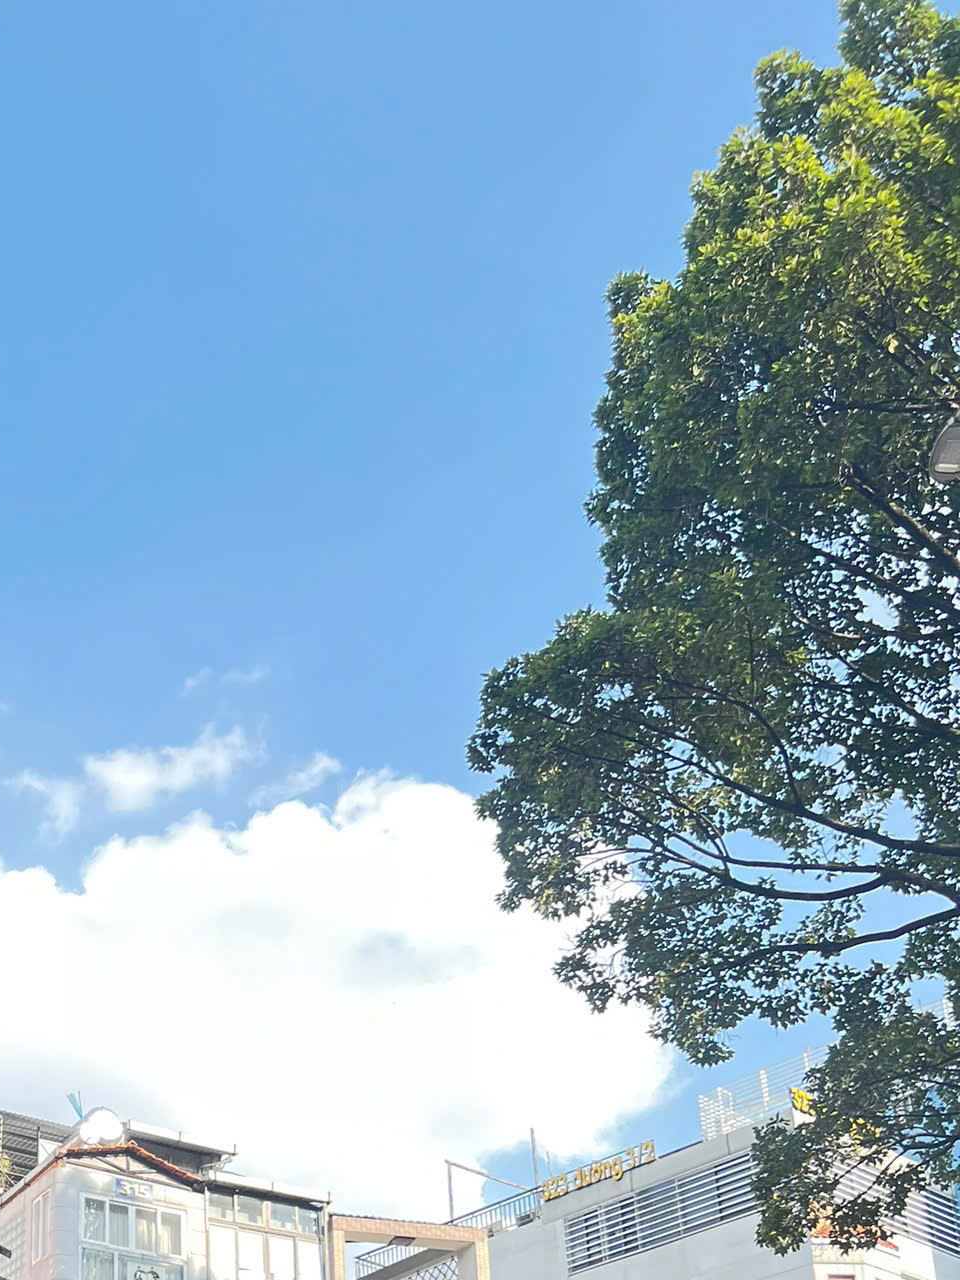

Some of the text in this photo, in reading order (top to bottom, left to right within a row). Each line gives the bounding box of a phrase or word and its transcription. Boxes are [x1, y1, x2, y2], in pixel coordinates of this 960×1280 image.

[119, 1181, 152, 1199] 315
[541, 1175, 568, 1202] 323
[625, 1140, 657, 1169] 3/2
